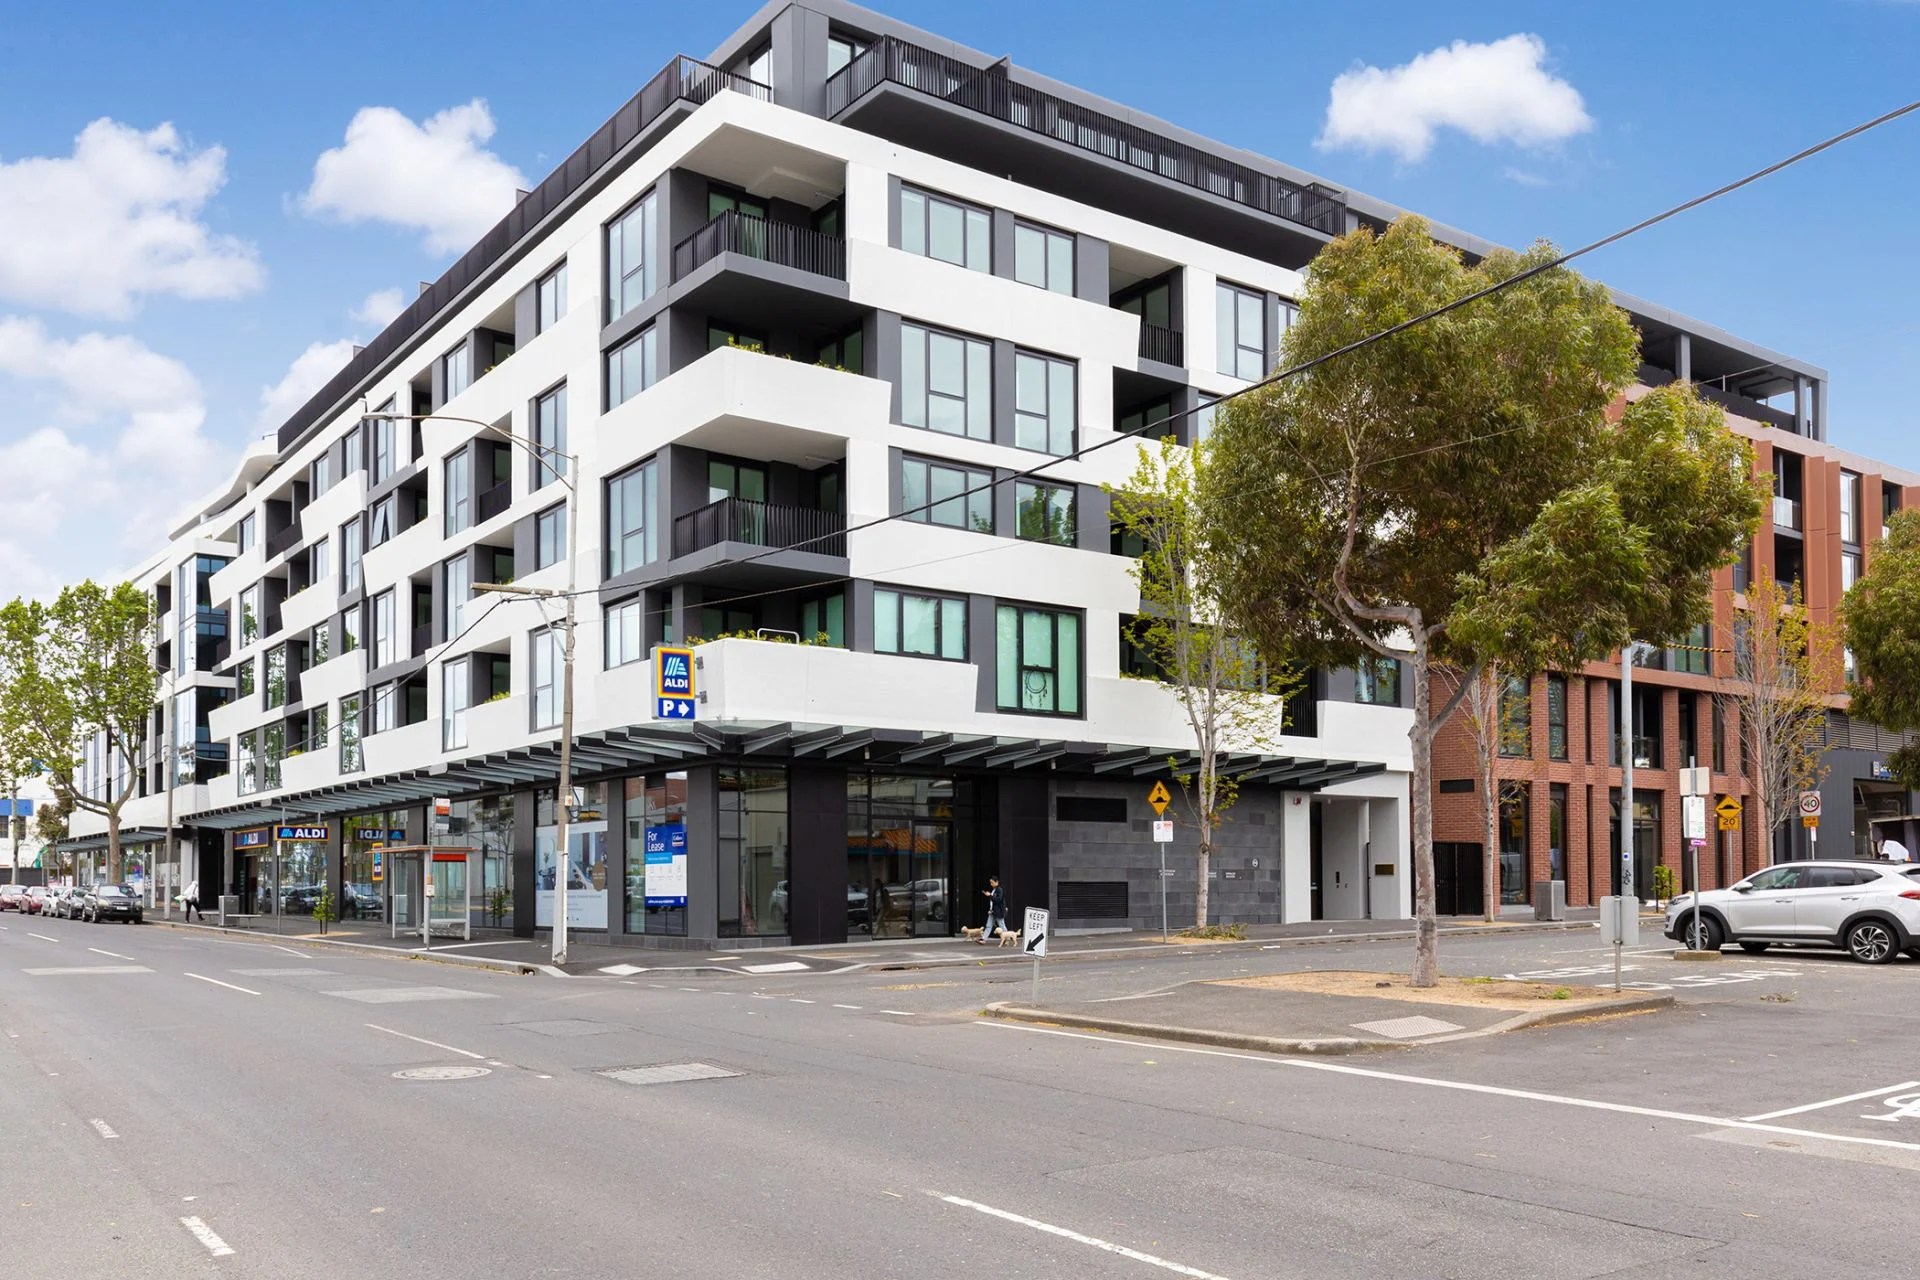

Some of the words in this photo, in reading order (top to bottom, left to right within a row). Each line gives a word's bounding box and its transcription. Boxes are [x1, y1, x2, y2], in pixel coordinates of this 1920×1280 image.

[664, 678, 688, 688] ALDI
[663, 700, 674, 716] P
[1804, 799, 1817, 808] 40
[1722, 818, 1736, 826] 20
[295, 828, 325, 838] ALDI
[647, 831, 658, 842] For
[248, 832, 259, 845] ALDI
[647, 842, 665, 852] Lease
[1029, 912, 1045, 921] KEEP
[1029, 921, 1044, 931] LEFT
